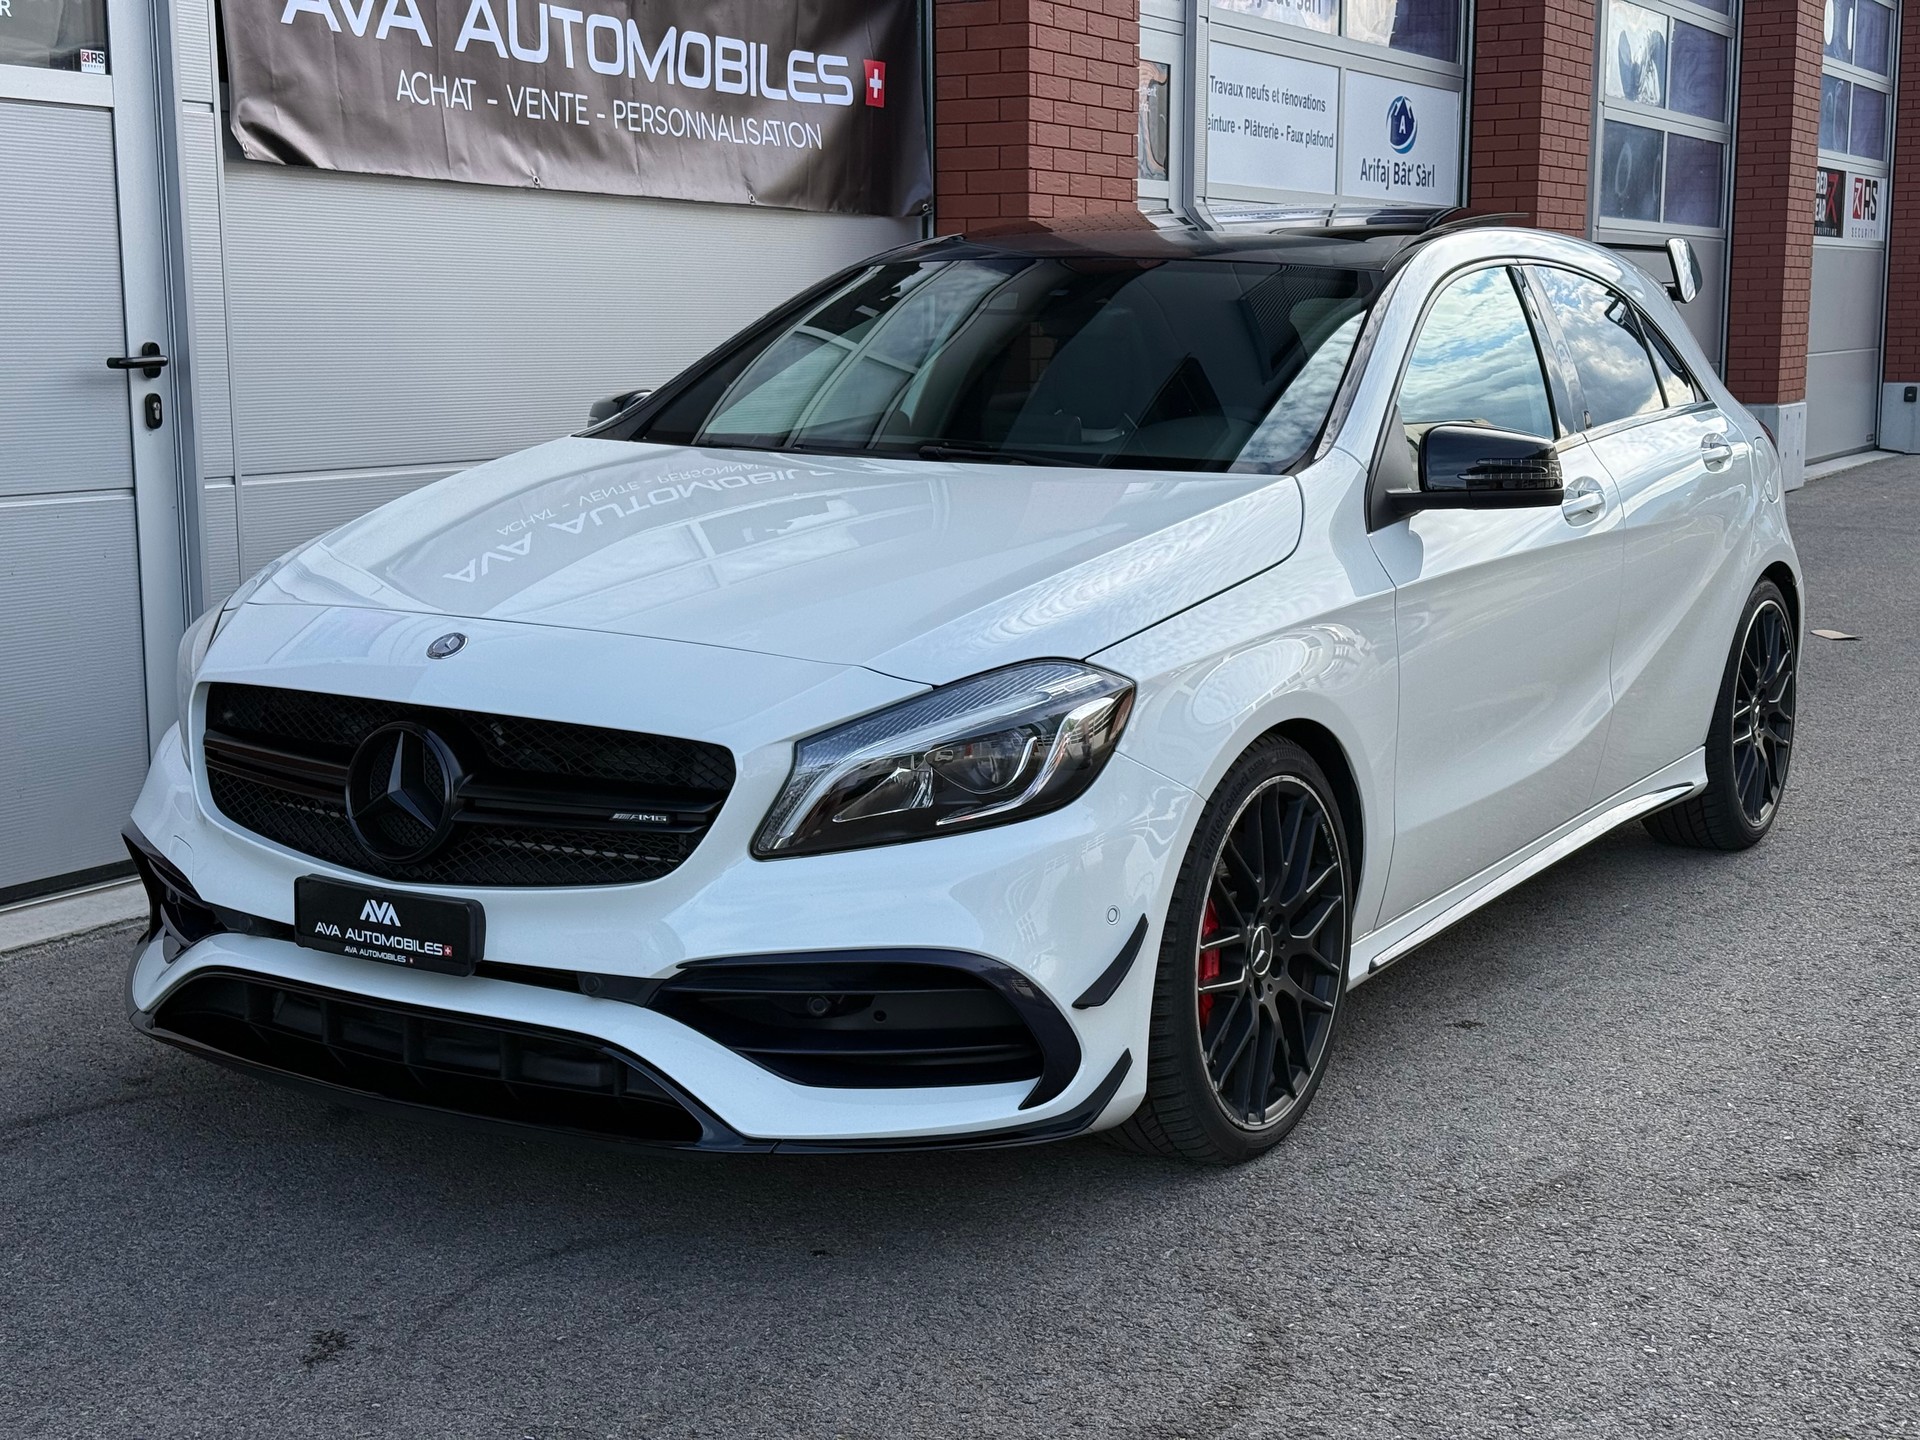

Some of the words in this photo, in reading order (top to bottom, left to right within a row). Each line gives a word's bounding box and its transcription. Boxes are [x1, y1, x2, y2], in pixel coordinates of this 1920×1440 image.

[455, 0, 854, 107] AUTOMOBILES
[397, 69, 477, 111] ACHAT
[507, 84, 590, 126] VENTE
[613, 99, 823, 150] PERSONNALISATION
[1210, 75, 1243, 98] Travaux
[1246, 84, 1270, 102] neufs
[1272, 88, 1280, 104] et
[1282, 88, 1326, 113] rénovations
[1208, 114, 1236, 134] einture
[1244, 118, 1279, 140] Plâtrerie
[1286, 125, 1304, 145] Faux
[1305, 129, 1334, 149] plafond
[1360, 158, 1390, 191] Arifaj
[1416, 163, 1435, 188] Sàrl
[314, 921, 342, 938] AVA
[345, 927, 444, 957] AUTOMOBILES
[344, 945, 358, 955] AVA
[359, 948, 407, 963] AUTOMOBILES
